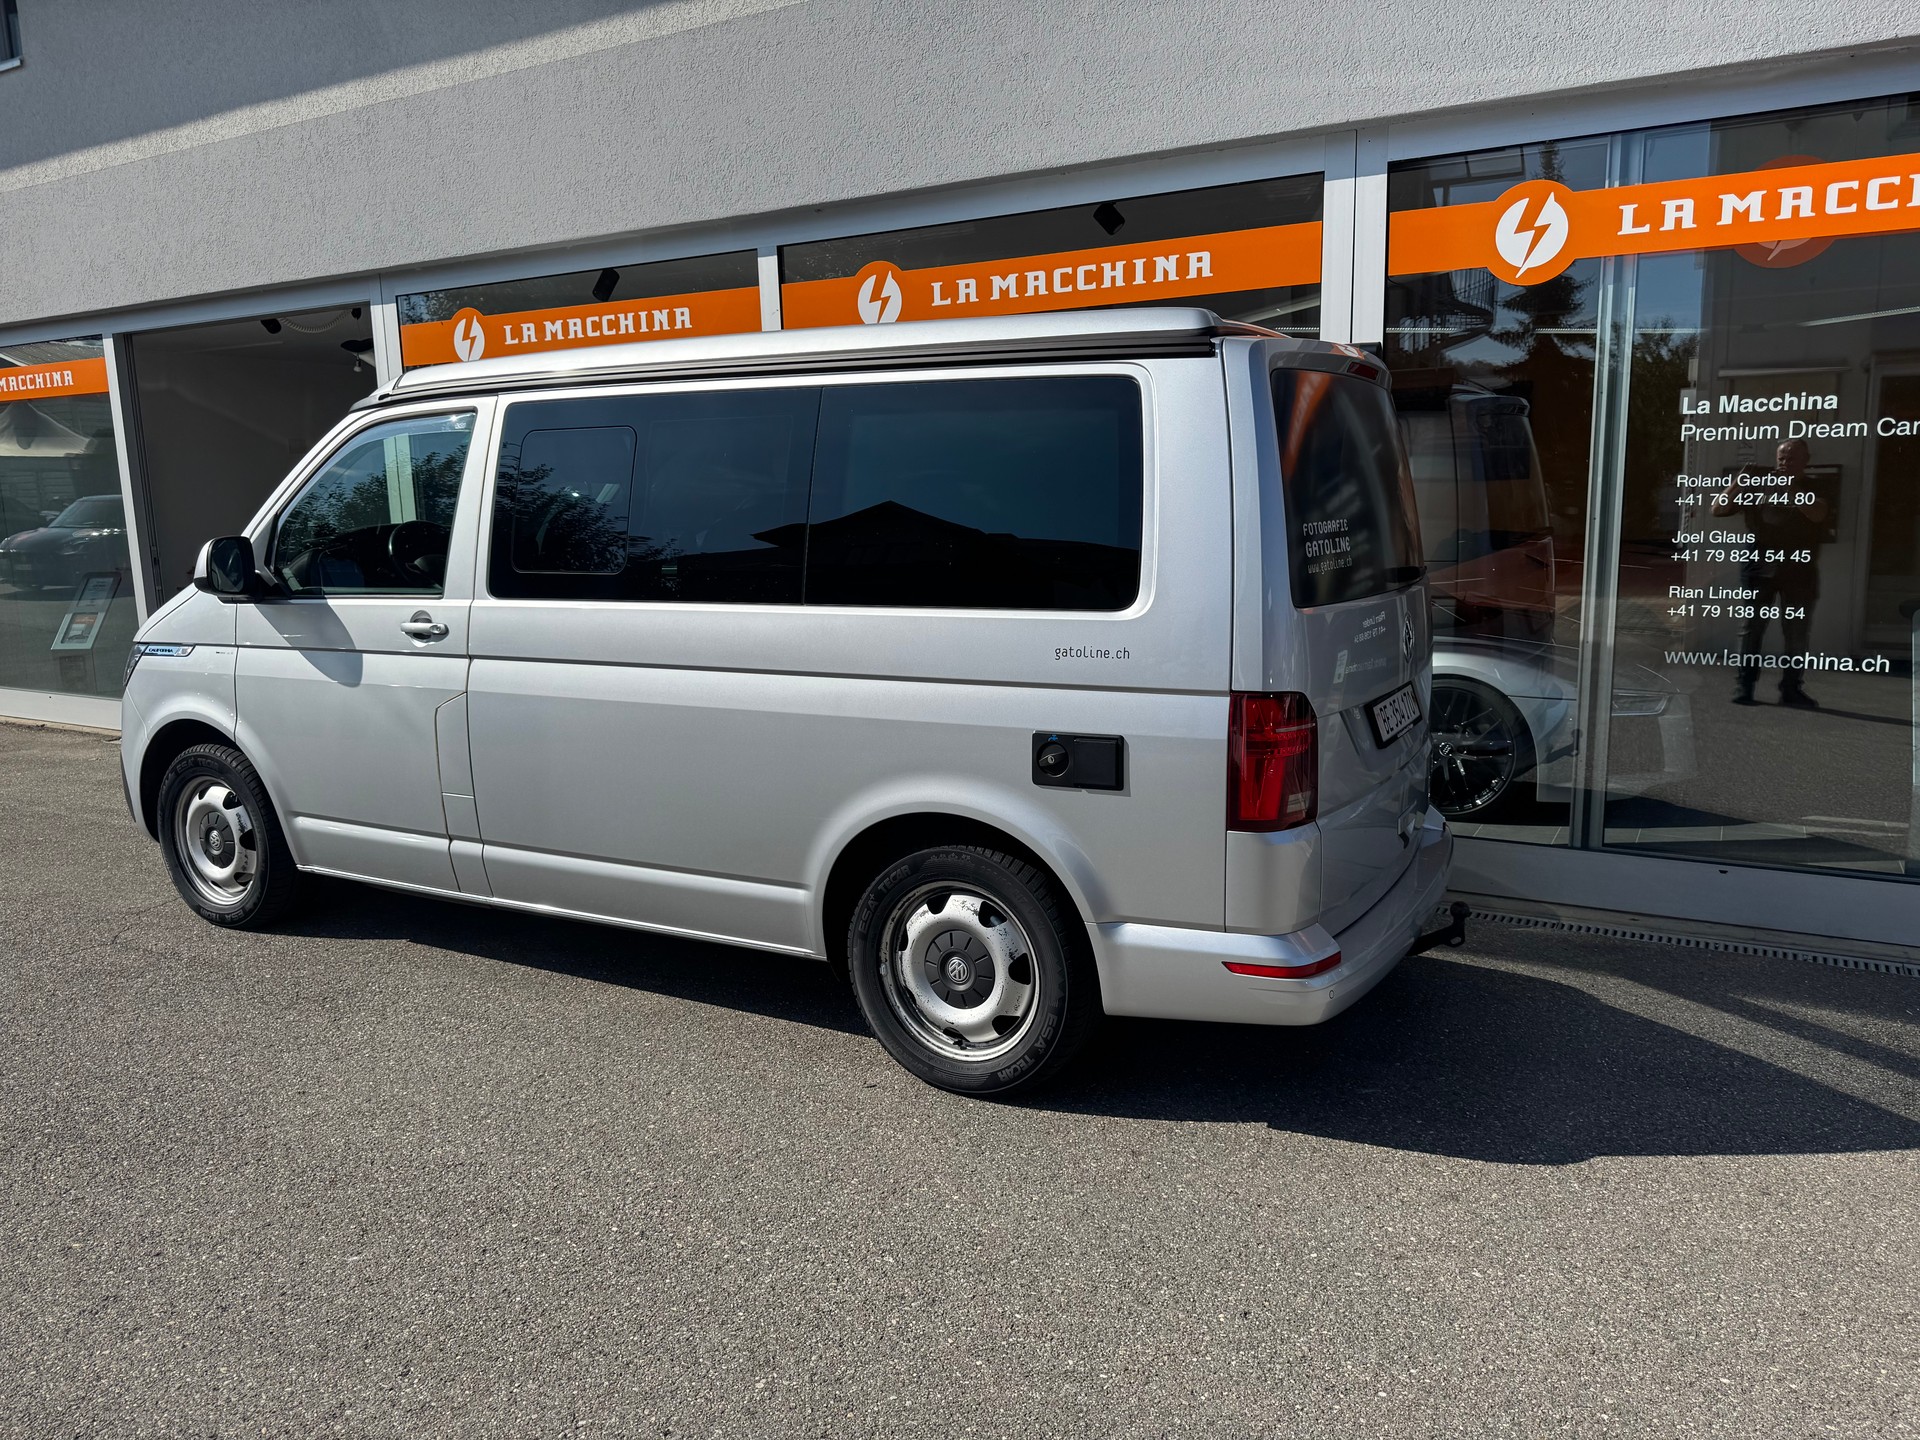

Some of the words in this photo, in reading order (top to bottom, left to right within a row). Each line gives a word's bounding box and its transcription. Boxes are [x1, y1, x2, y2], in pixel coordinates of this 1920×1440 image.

[1617, 198, 1697, 236] LA
[930, 278, 979, 306] LA
[990, 251, 1214, 300] MACCHINA
[503, 322, 537, 345] LA
[543, 307, 692, 342] MACCHINA
[1682, 397, 1710, 415] La
[1719, 391, 1838, 414] Macchina
[1680, 422, 1780, 442] Premium
[1788, 420, 1868, 439] Dream
[1876, 417, 1920, 437] Car
[1676, 473, 1732, 488] Roland
[1737, 473, 1794, 487] Gerber
[1675, 496, 1702, 506] +41
[1709, 495, 1729, 507] 76
[1733, 493, 1764, 506] 427
[1768, 493, 1790, 506] 44
[1794, 491, 1816, 506] 80
[1302, 518, 1349, 536] FOTOGRAFIE
[1671, 530, 1704, 544] Joel
[1708, 530, 1756, 544] Glaus
[1305, 536, 1351, 558] GATOLINE
[1670, 550, 1699, 562] +41
[1705, 549, 1725, 562] 79
[1729, 550, 1760, 562] 824
[1764, 550, 1786, 563] 54
[1790, 550, 1811, 563] 45
[1668, 585, 1704, 599] Rian
[1708, 586, 1759, 600] Linder
[1666, 604, 1695, 617] +41
[1701, 604, 1721, 618] 79
[1726, 605, 1755, 619] 138
[1759, 606, 1780, 620] 68
[1784, 607, 1806, 620] 54
[1054, 646, 1131, 661] gatoline.ch
[1664, 648, 1890, 673] www.lamacchina.ch
